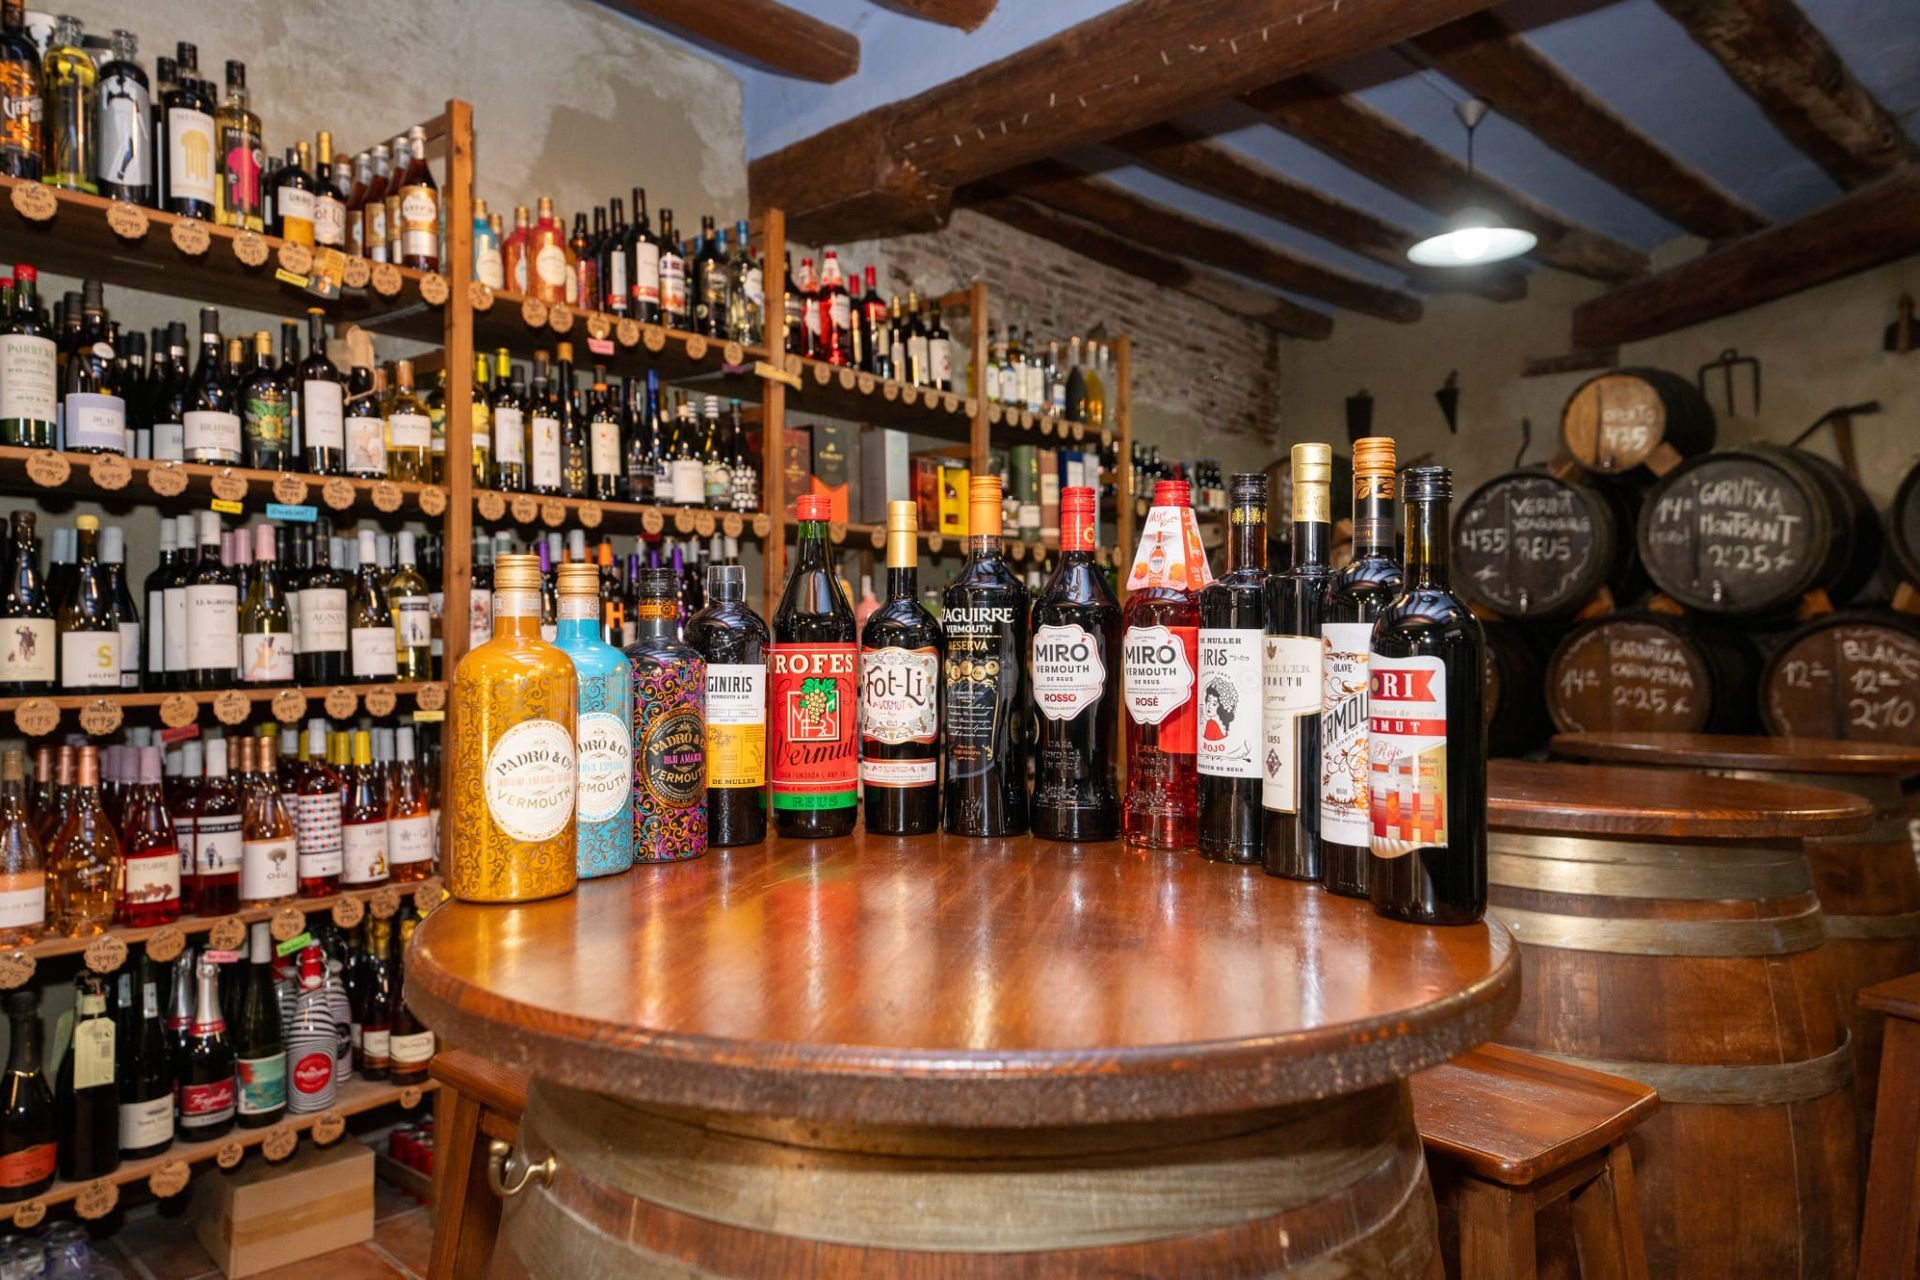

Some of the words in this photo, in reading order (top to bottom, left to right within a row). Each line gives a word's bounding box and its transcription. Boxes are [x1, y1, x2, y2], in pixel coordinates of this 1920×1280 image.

[941, 607, 1015, 624] ZAGUIRRE
[946, 624, 993, 634] VERMOUTH
[948, 640, 989, 650] RESERVA
[1035, 637, 1089, 663] MIRÓ
[1207, 637, 1243, 645] MULLER
[97, 644, 113, 668] S
[1125, 639, 1176, 665] MIRÓ
[1203, 648, 1228, 666] IRIS
[775, 653, 854, 674] ROFES
[1036, 664, 1090, 674] VERMOUTH
[1126, 667, 1177, 677] VERMOUTH
[707, 676, 753, 693] GINIRIS
[866, 665, 926, 707] Fot-Li
[1044, 693, 1077, 703] ROSSO
[1135, 695, 1159, 707] ROSÉ
[578, 737, 607, 755] DRÓ
[649, 733, 692, 756] PADRÓ
[776, 724, 857, 768] Vermut
[1202, 742, 1226, 753] ROJO
[495, 749, 550, 777] PADRÓ
[578, 772, 628, 794] RMOUTH
[650, 765, 703, 784] VERMOUT
[497, 785, 572, 810] VERMOUTH
[791, 796, 839, 809] REUS
